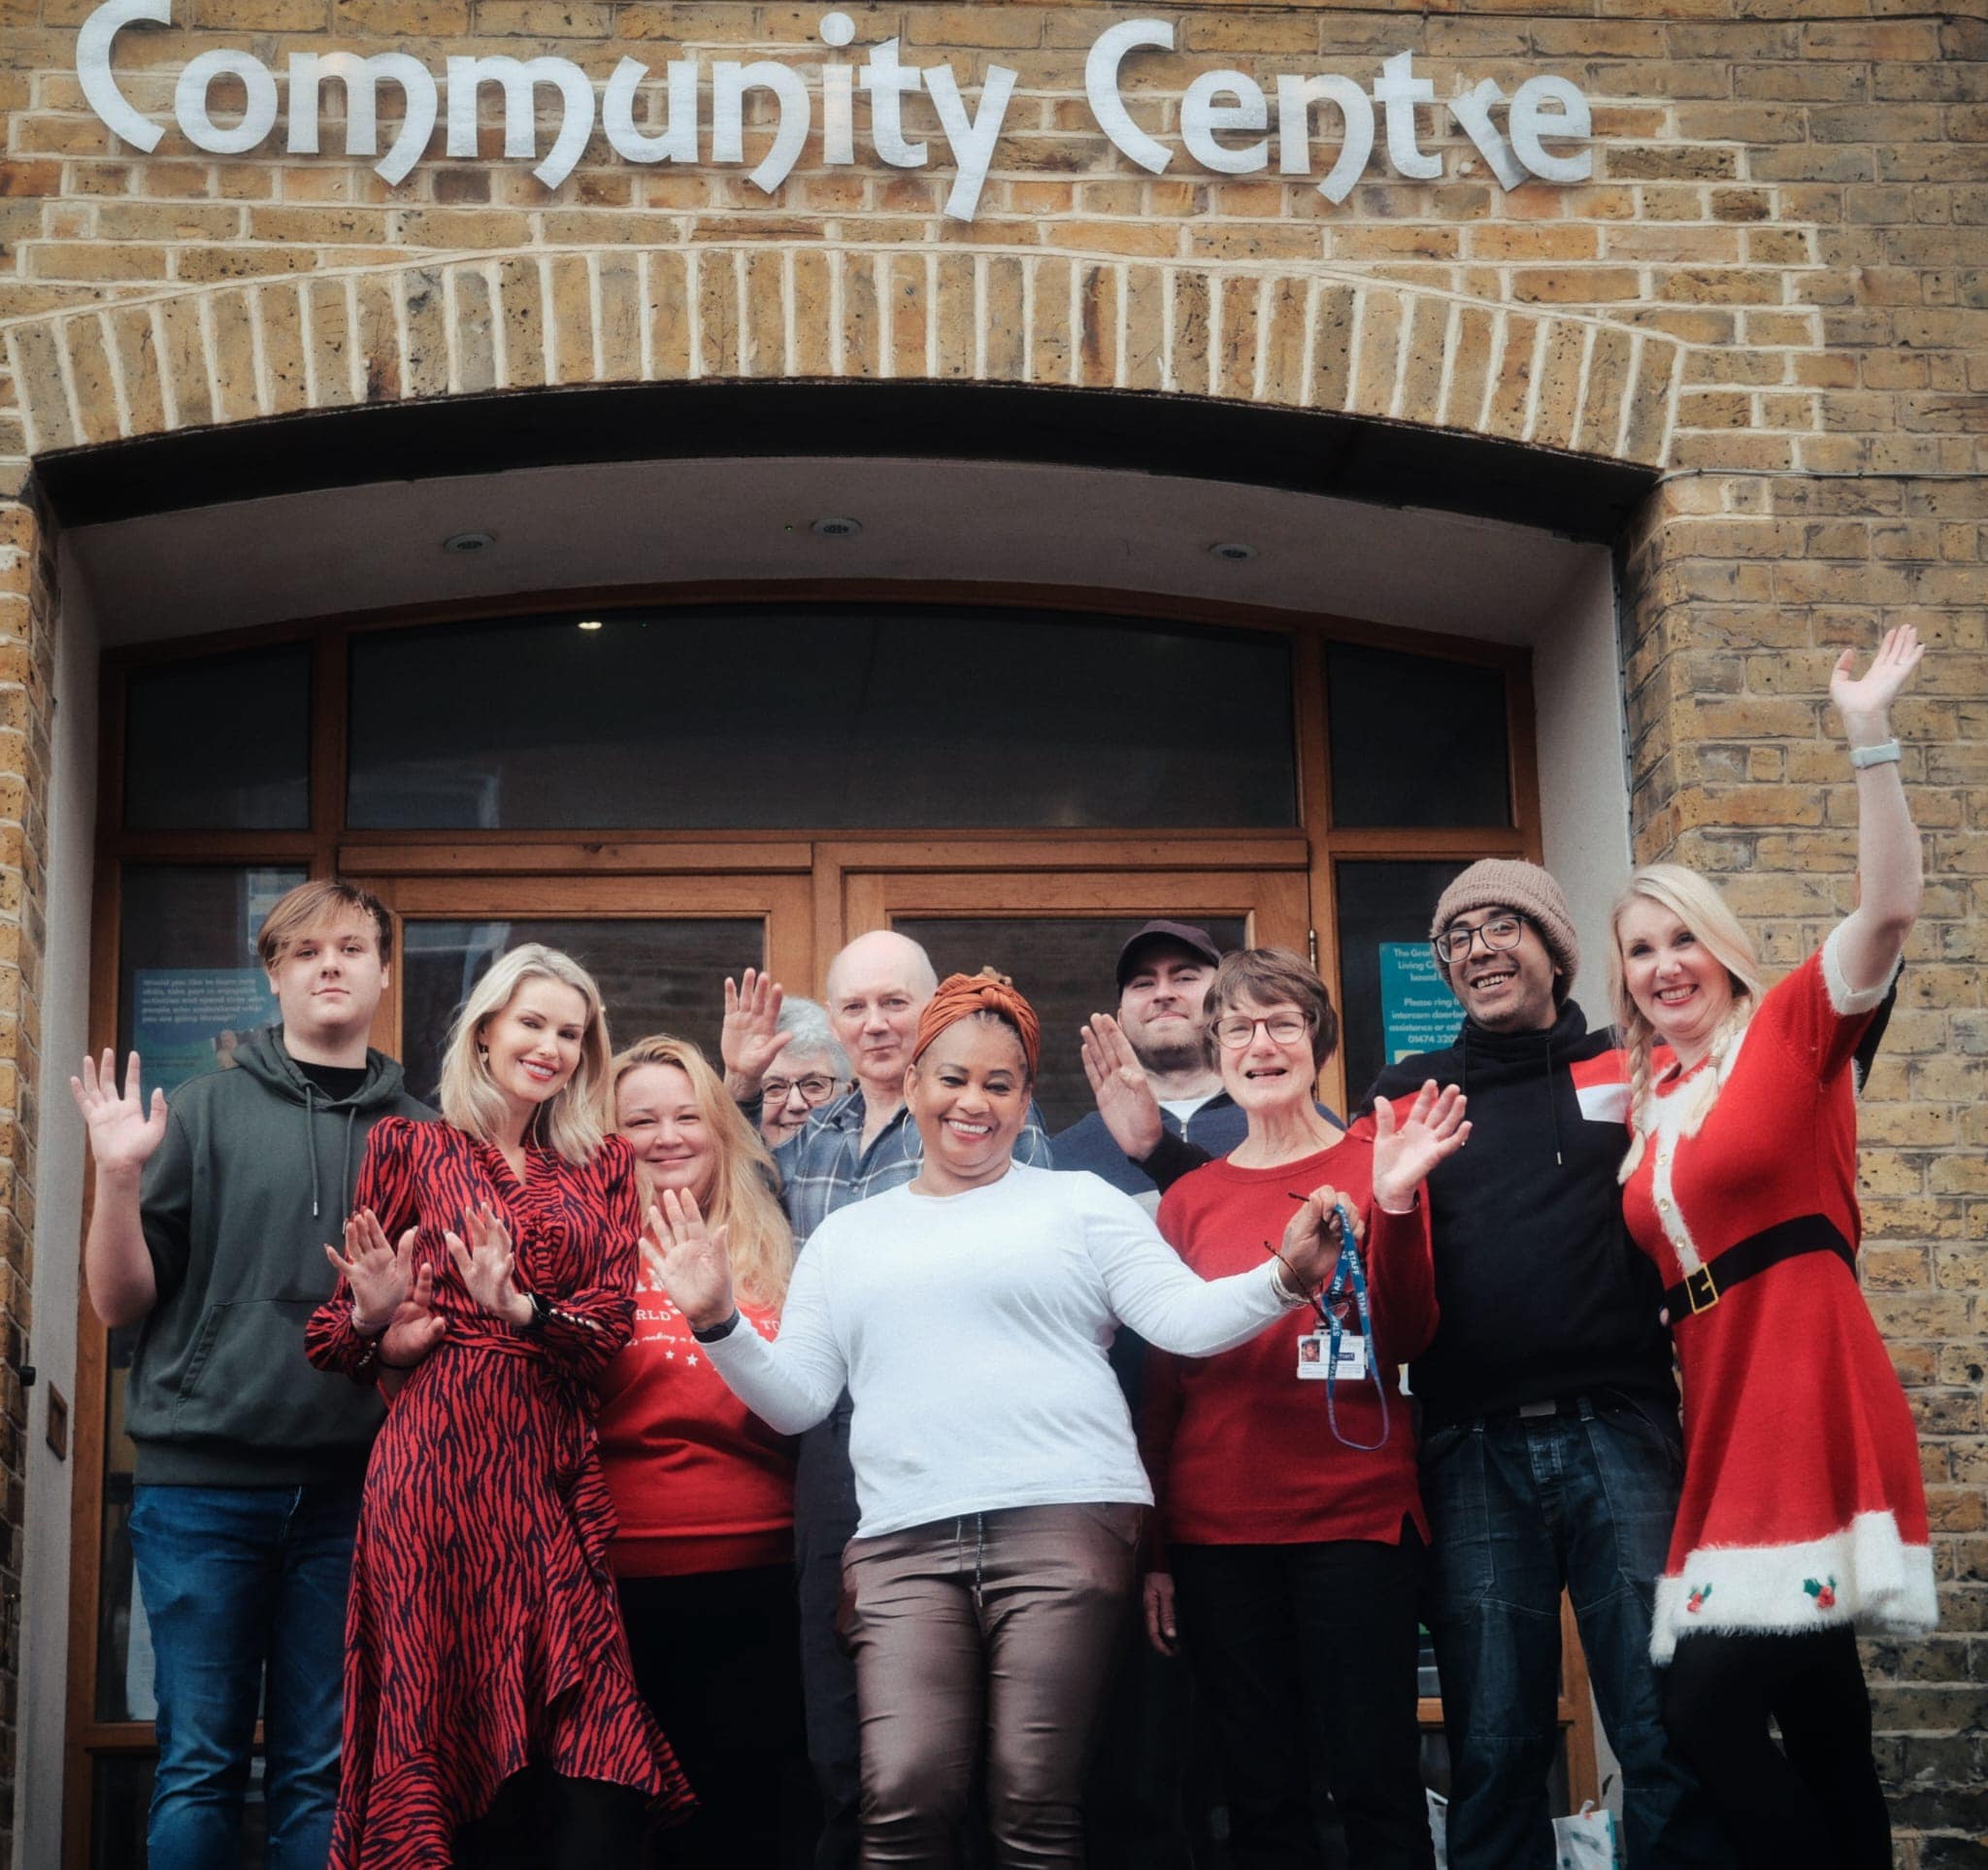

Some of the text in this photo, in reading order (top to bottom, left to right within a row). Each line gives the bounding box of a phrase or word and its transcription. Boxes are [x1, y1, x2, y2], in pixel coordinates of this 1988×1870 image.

[76, 0, 1592, 222] Community Centre
[1393, 948, 1409, 957] The
[1398, 960, 1424, 971] Living
[1404, 997, 1432, 1007] Please
[1434, 997, 1452, 1008] ring
[1391, 1011, 1430, 1019] intercom
[1388, 1022, 1433, 1032] assistance
[1407, 1035, 1435, 1044] 01474
[1347, 1251, 1360, 1275] STAFF
[636, 1309, 780, 1333] RLD TO
